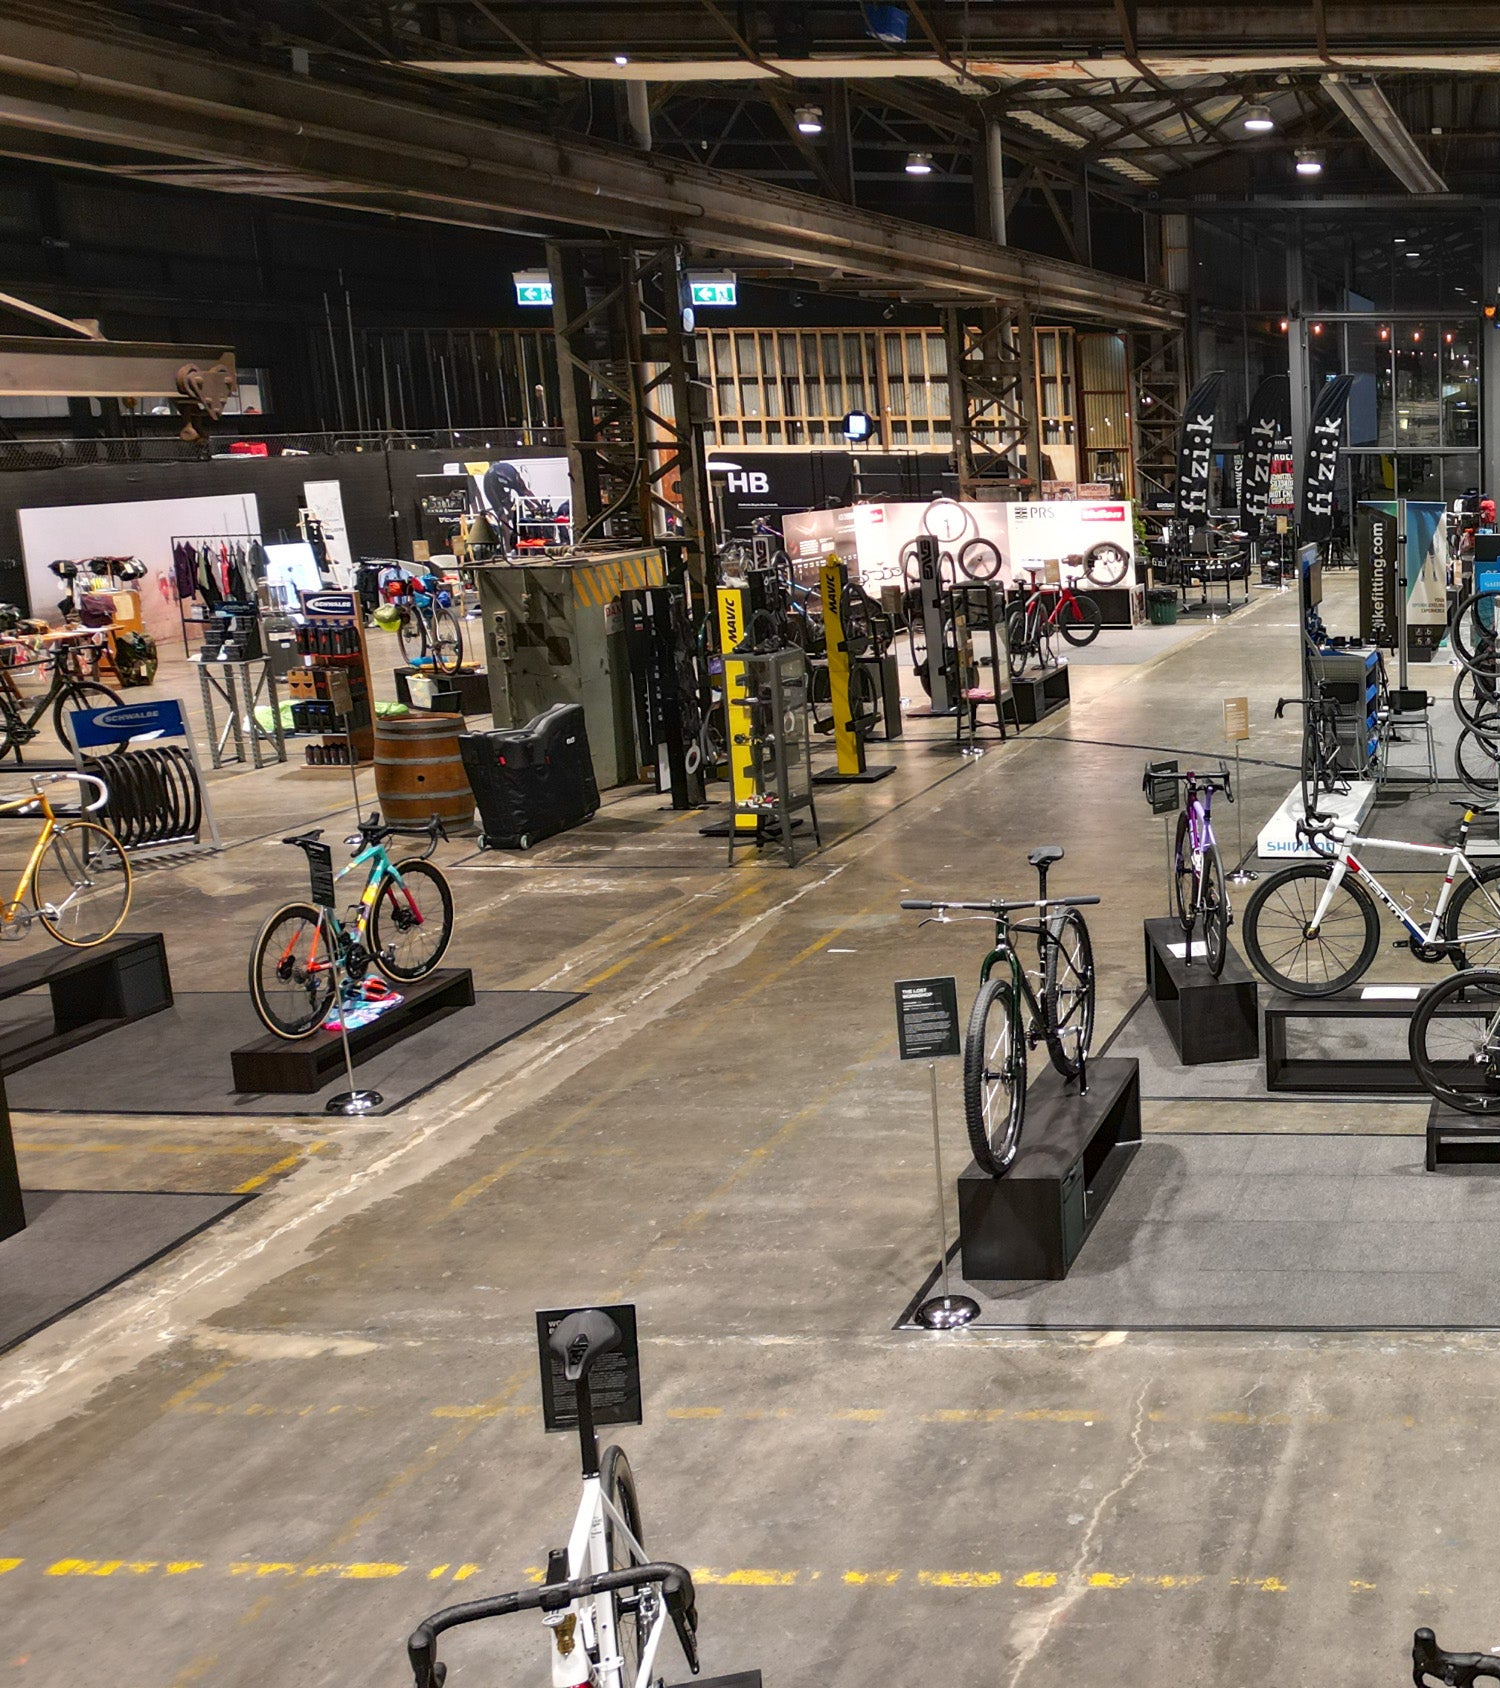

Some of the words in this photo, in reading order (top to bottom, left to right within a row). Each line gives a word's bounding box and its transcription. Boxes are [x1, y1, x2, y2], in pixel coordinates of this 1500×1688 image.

[727, 472, 770, 493] HB
[826, 573, 839, 615] MAVIC
[725, 598, 738, 644] MAVIC
[105, 710, 159, 723] SCHWALBE
